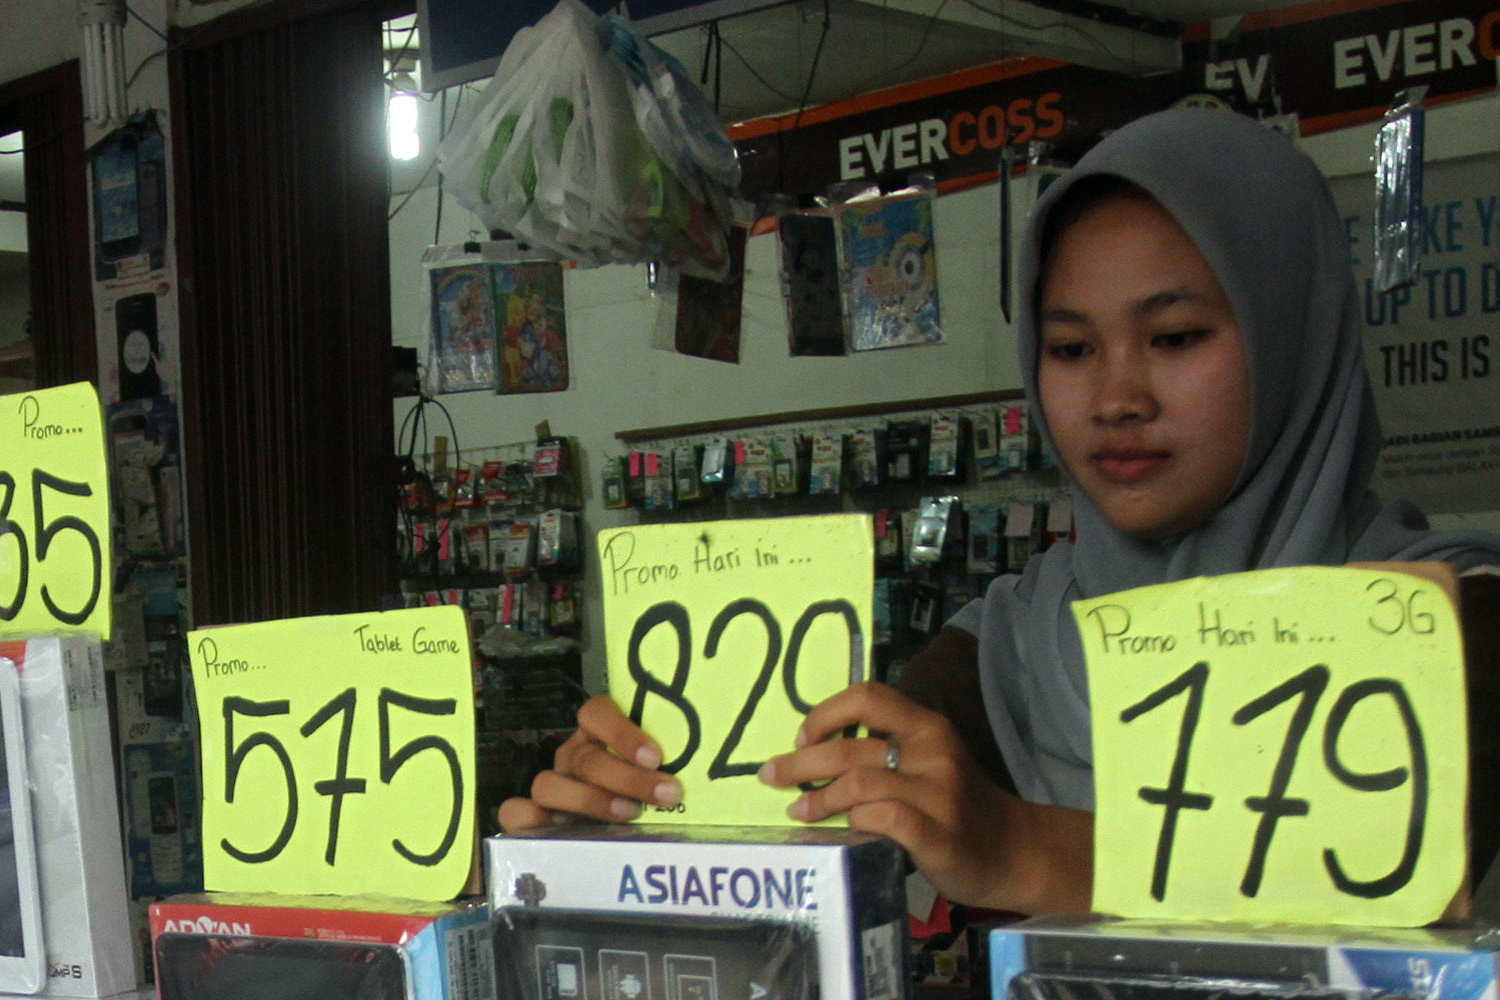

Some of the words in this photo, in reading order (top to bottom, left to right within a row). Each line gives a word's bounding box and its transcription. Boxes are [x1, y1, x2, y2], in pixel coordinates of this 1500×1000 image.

[840, 92, 1065, 181] EVERCOSS
[1428, 266, 1466, 319] TO
[1381, 340, 1448, 388] THIS
[1461, 335, 1490, 380] IS
[604, 531, 678, 596] Promo
[694, 536, 741, 572] Hari
[354, 624, 401, 654] Tablet
[412, 629, 460, 655] Game
[1087, 604, 1176, 655] Promo
[1198, 602, 1255, 647] Hari
[1368, 578, 1436, 636] 3G
[222, 687, 464, 867] 575
[1120, 661, 1428, 903] 779
[617, 864, 818, 910] ASIAFONE
[164, 916, 251, 936] ADVAN
